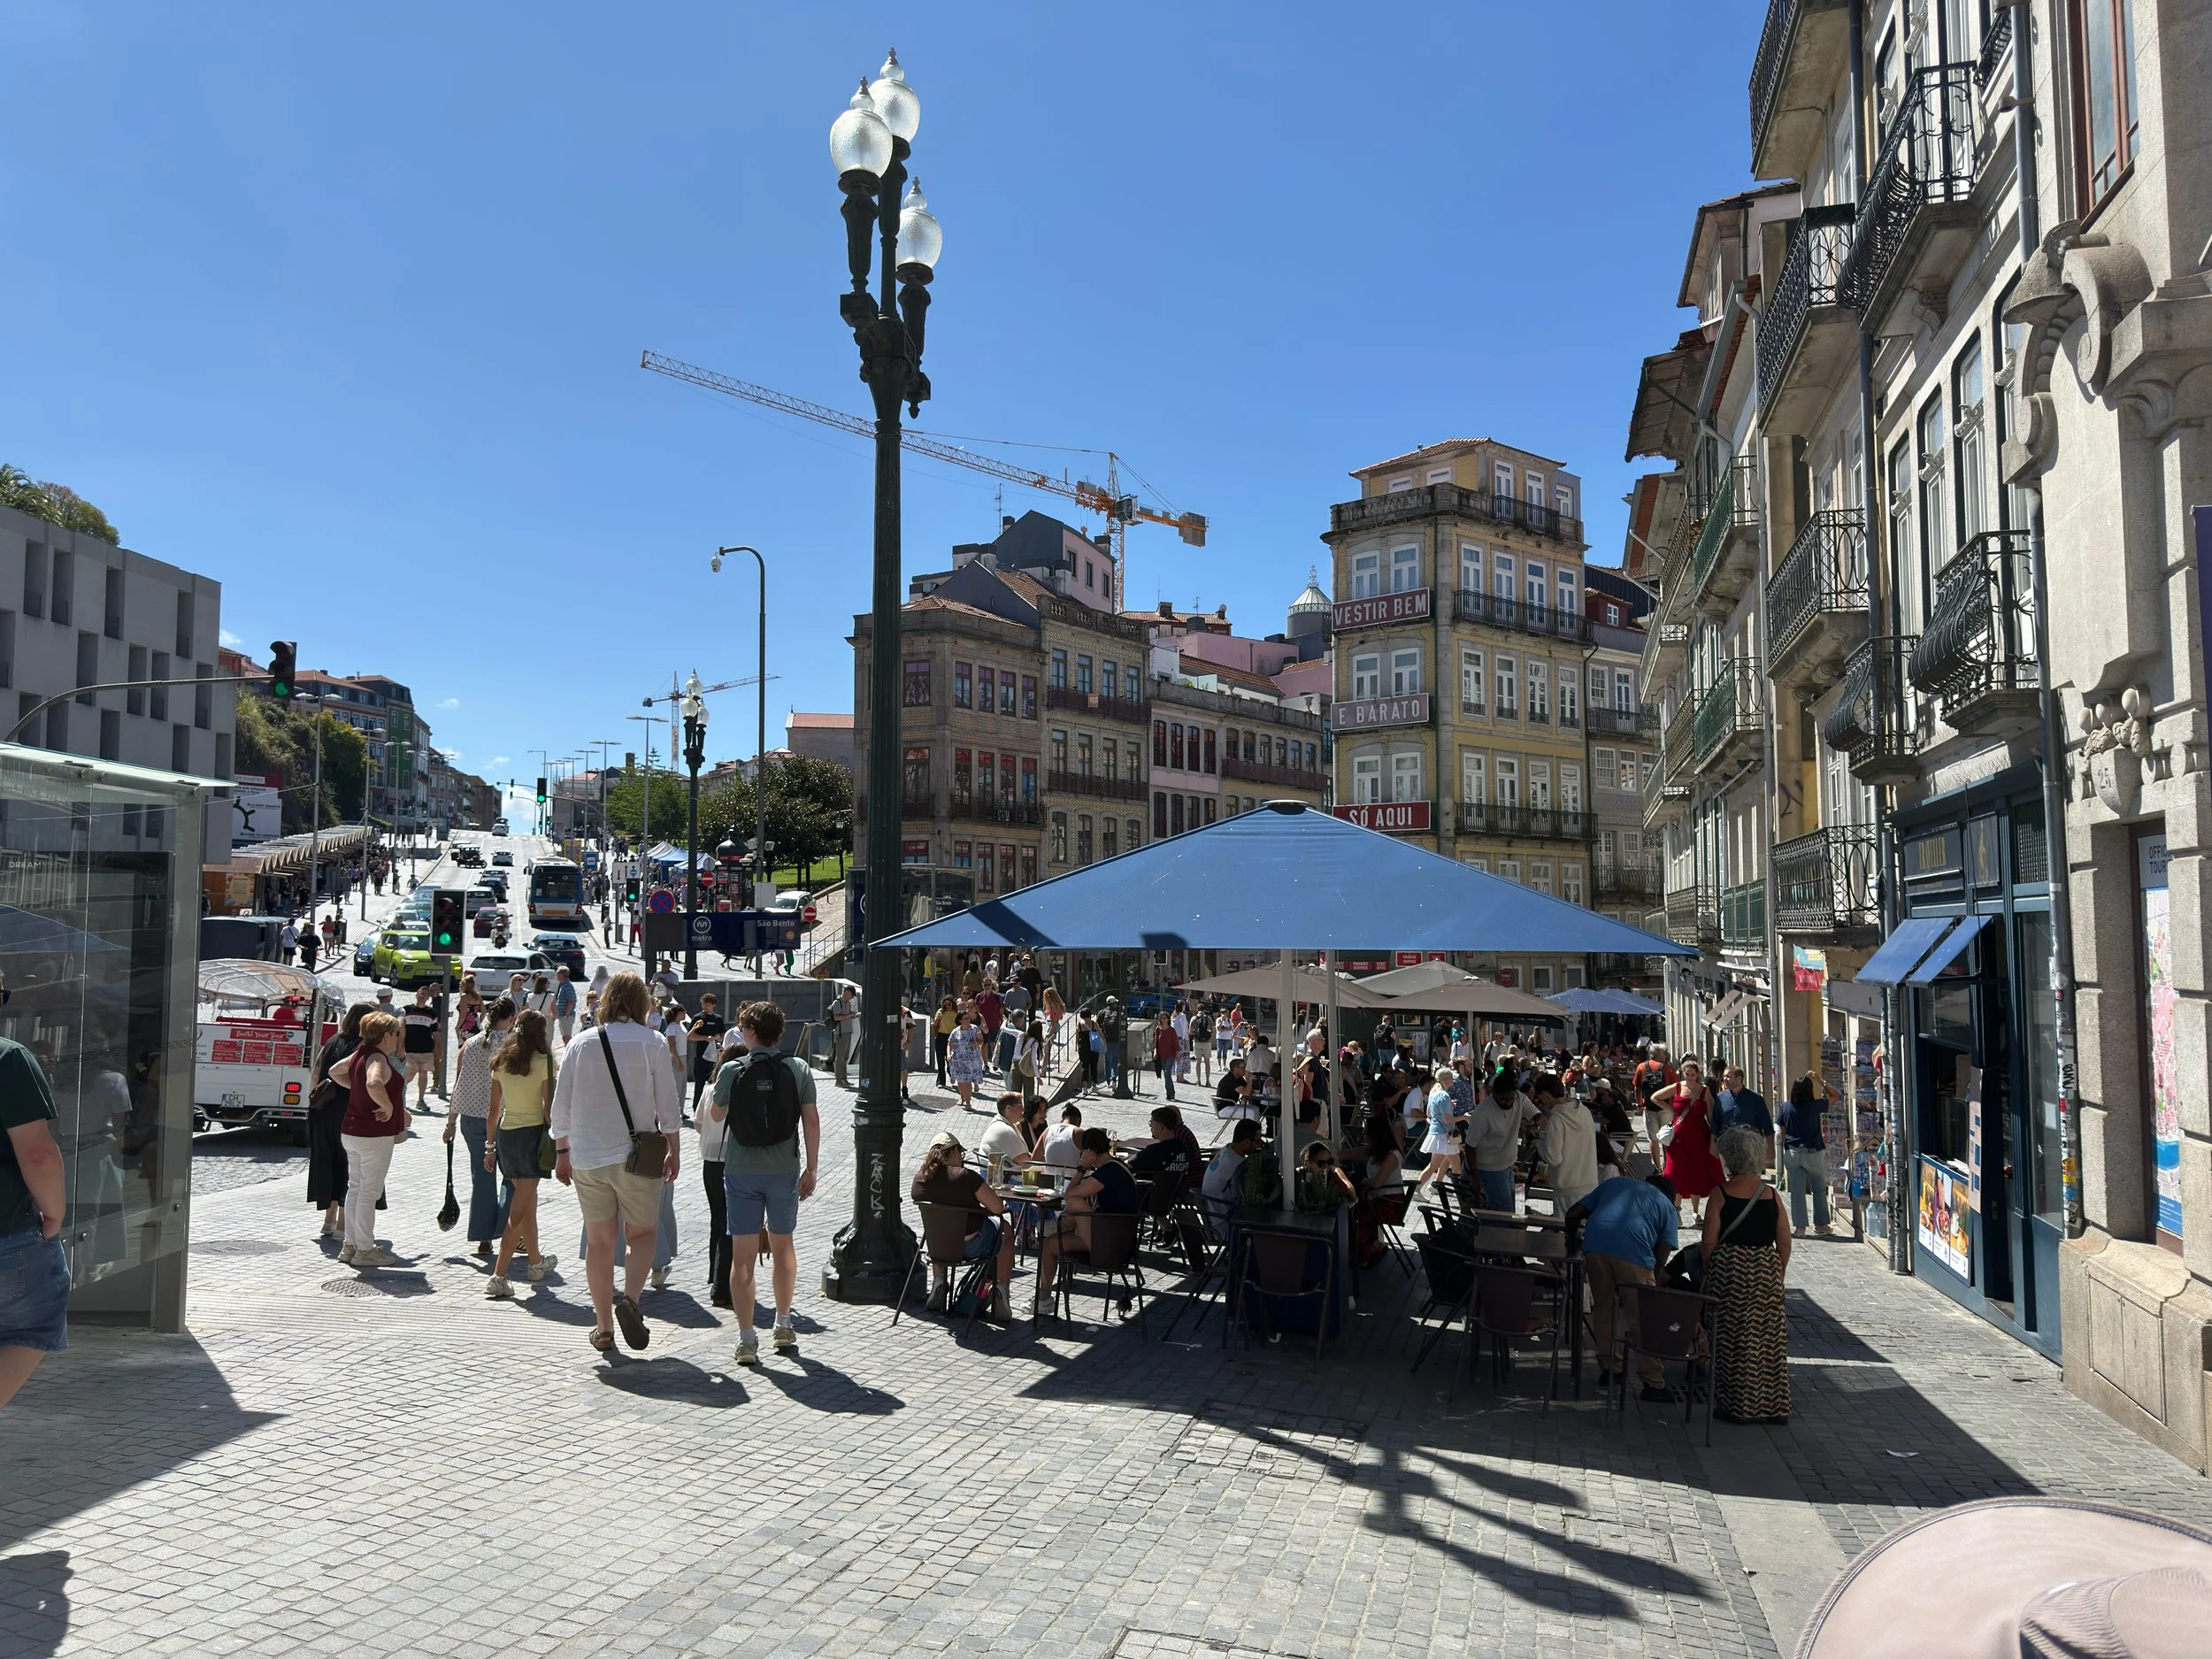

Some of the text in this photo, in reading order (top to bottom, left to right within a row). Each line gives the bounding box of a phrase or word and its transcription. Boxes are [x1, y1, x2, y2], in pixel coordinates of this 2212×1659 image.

[1334, 594, 1426, 626] VESTIR BEM
[1339, 699, 1420, 726] E BARATO
[1349, 806, 1412, 827] SÓ AQUI
